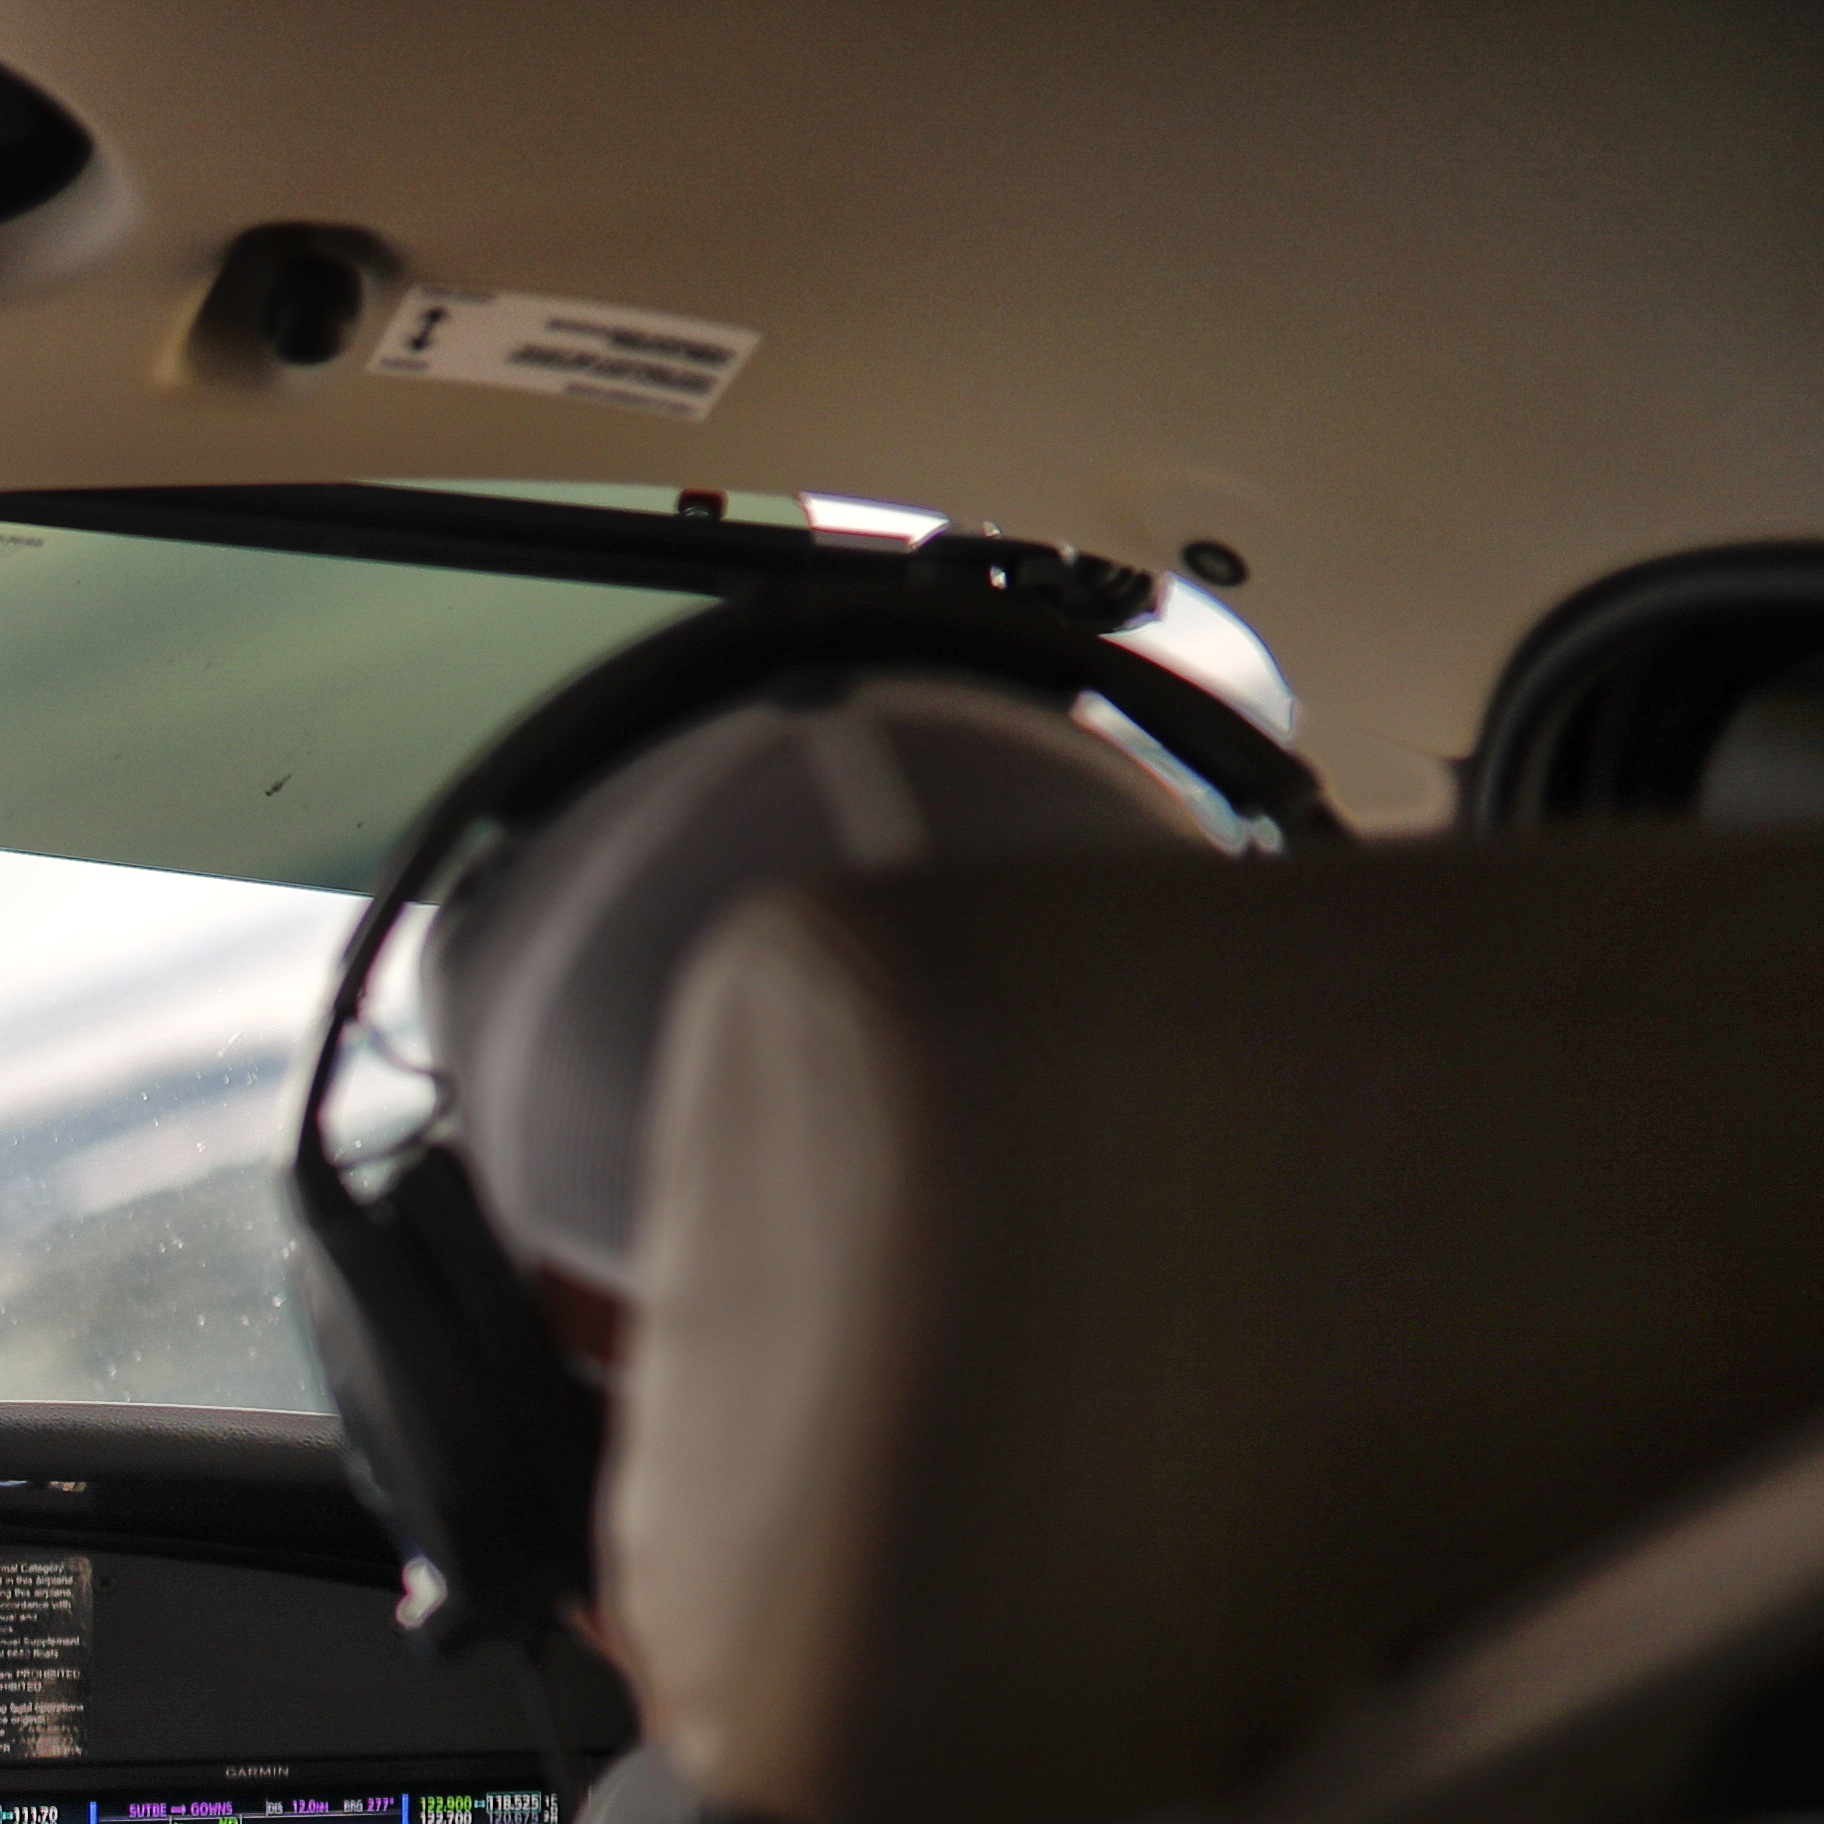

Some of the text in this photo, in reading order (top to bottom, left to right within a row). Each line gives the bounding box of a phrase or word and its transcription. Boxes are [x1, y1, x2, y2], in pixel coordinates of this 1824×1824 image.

[16, 1576, 33, 1587] this
[224, 1765, 291, 1779] GARMIN
[129, 1802, 233, 1817] SUTBE GOWNS
[487, 1796, 540, 1810] 118.525
[14, 1806, 58, 1822] 111.70
